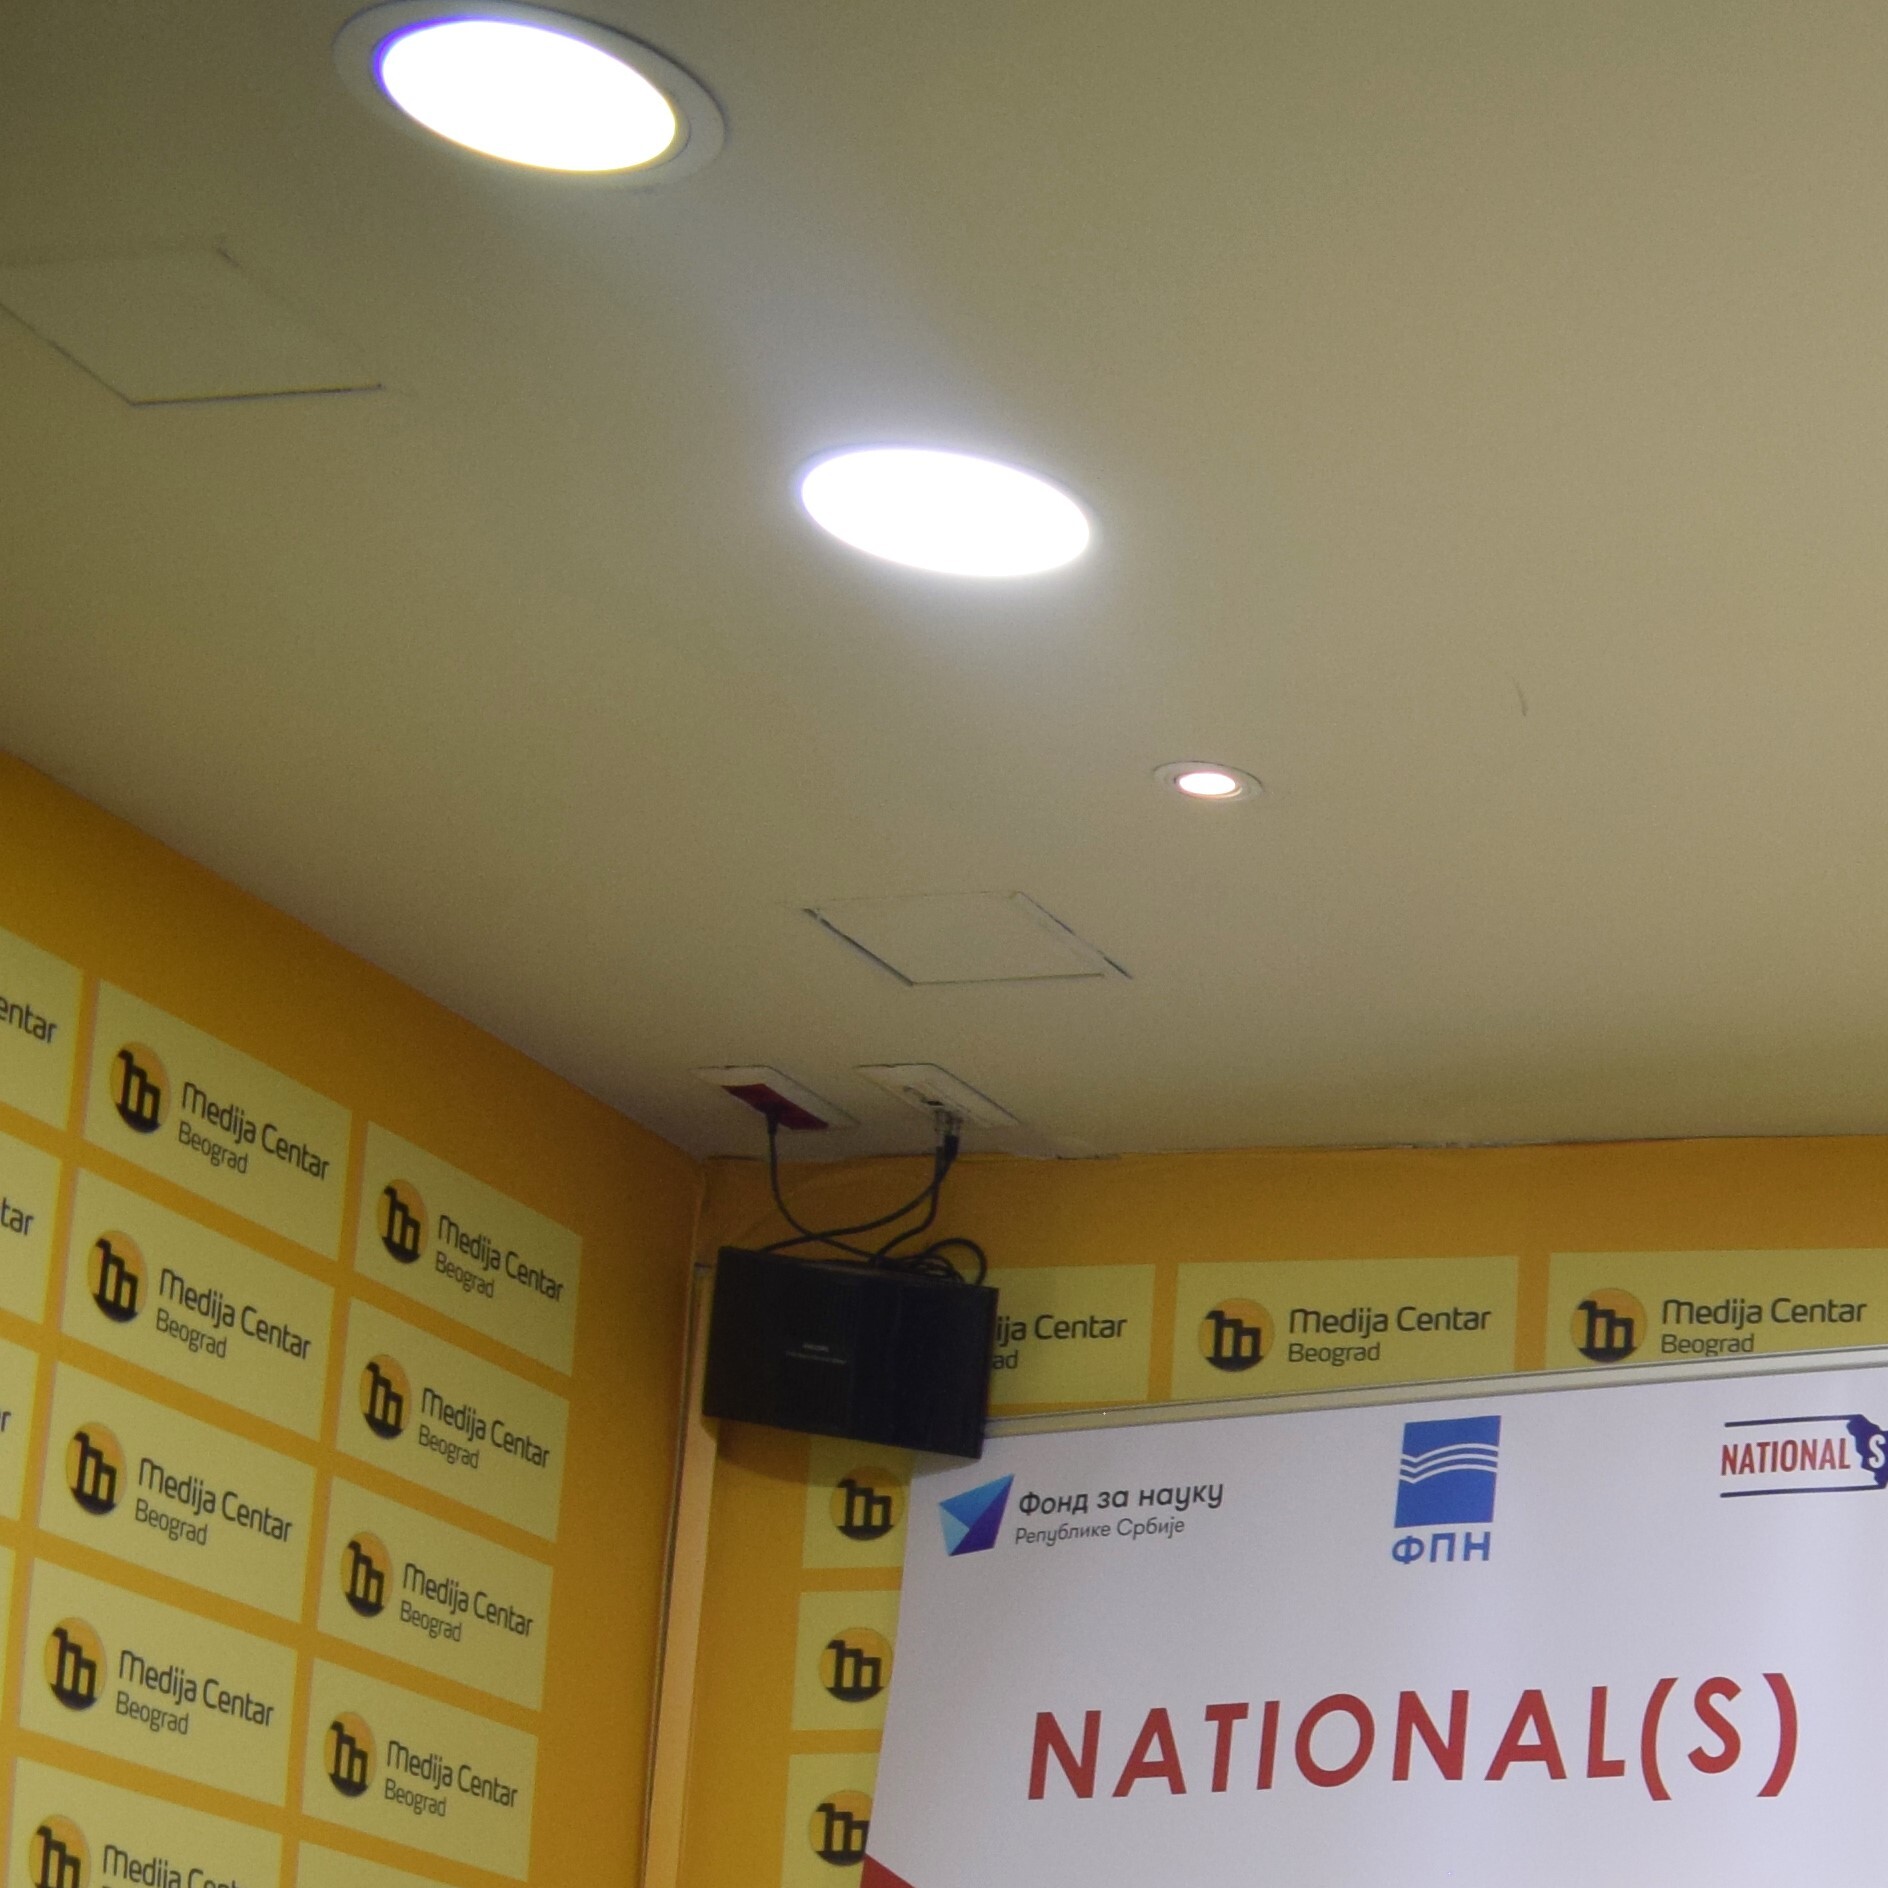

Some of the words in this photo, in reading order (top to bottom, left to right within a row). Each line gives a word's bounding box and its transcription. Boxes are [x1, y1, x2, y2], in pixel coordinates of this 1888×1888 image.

[178, 1122, 249, 1175] Beograd
[181, 1080, 257, 1144] Medija
[261, 1122, 330, 1180] Centar
[1721, 1438, 1850, 1476] NATIONAL
[1018, 1490, 1089, 1517] Фонд
[1096, 1489, 1129, 1510] за
[1138, 1483, 1224, 1512] науку
[1014, 1522, 1112, 1548] Републике
[1116, 1516, 1185, 1541] Србије
[1391, 1531, 1491, 1565] ФПН
[1027, 1672, 1798, 1802] NATIONAL(S)
